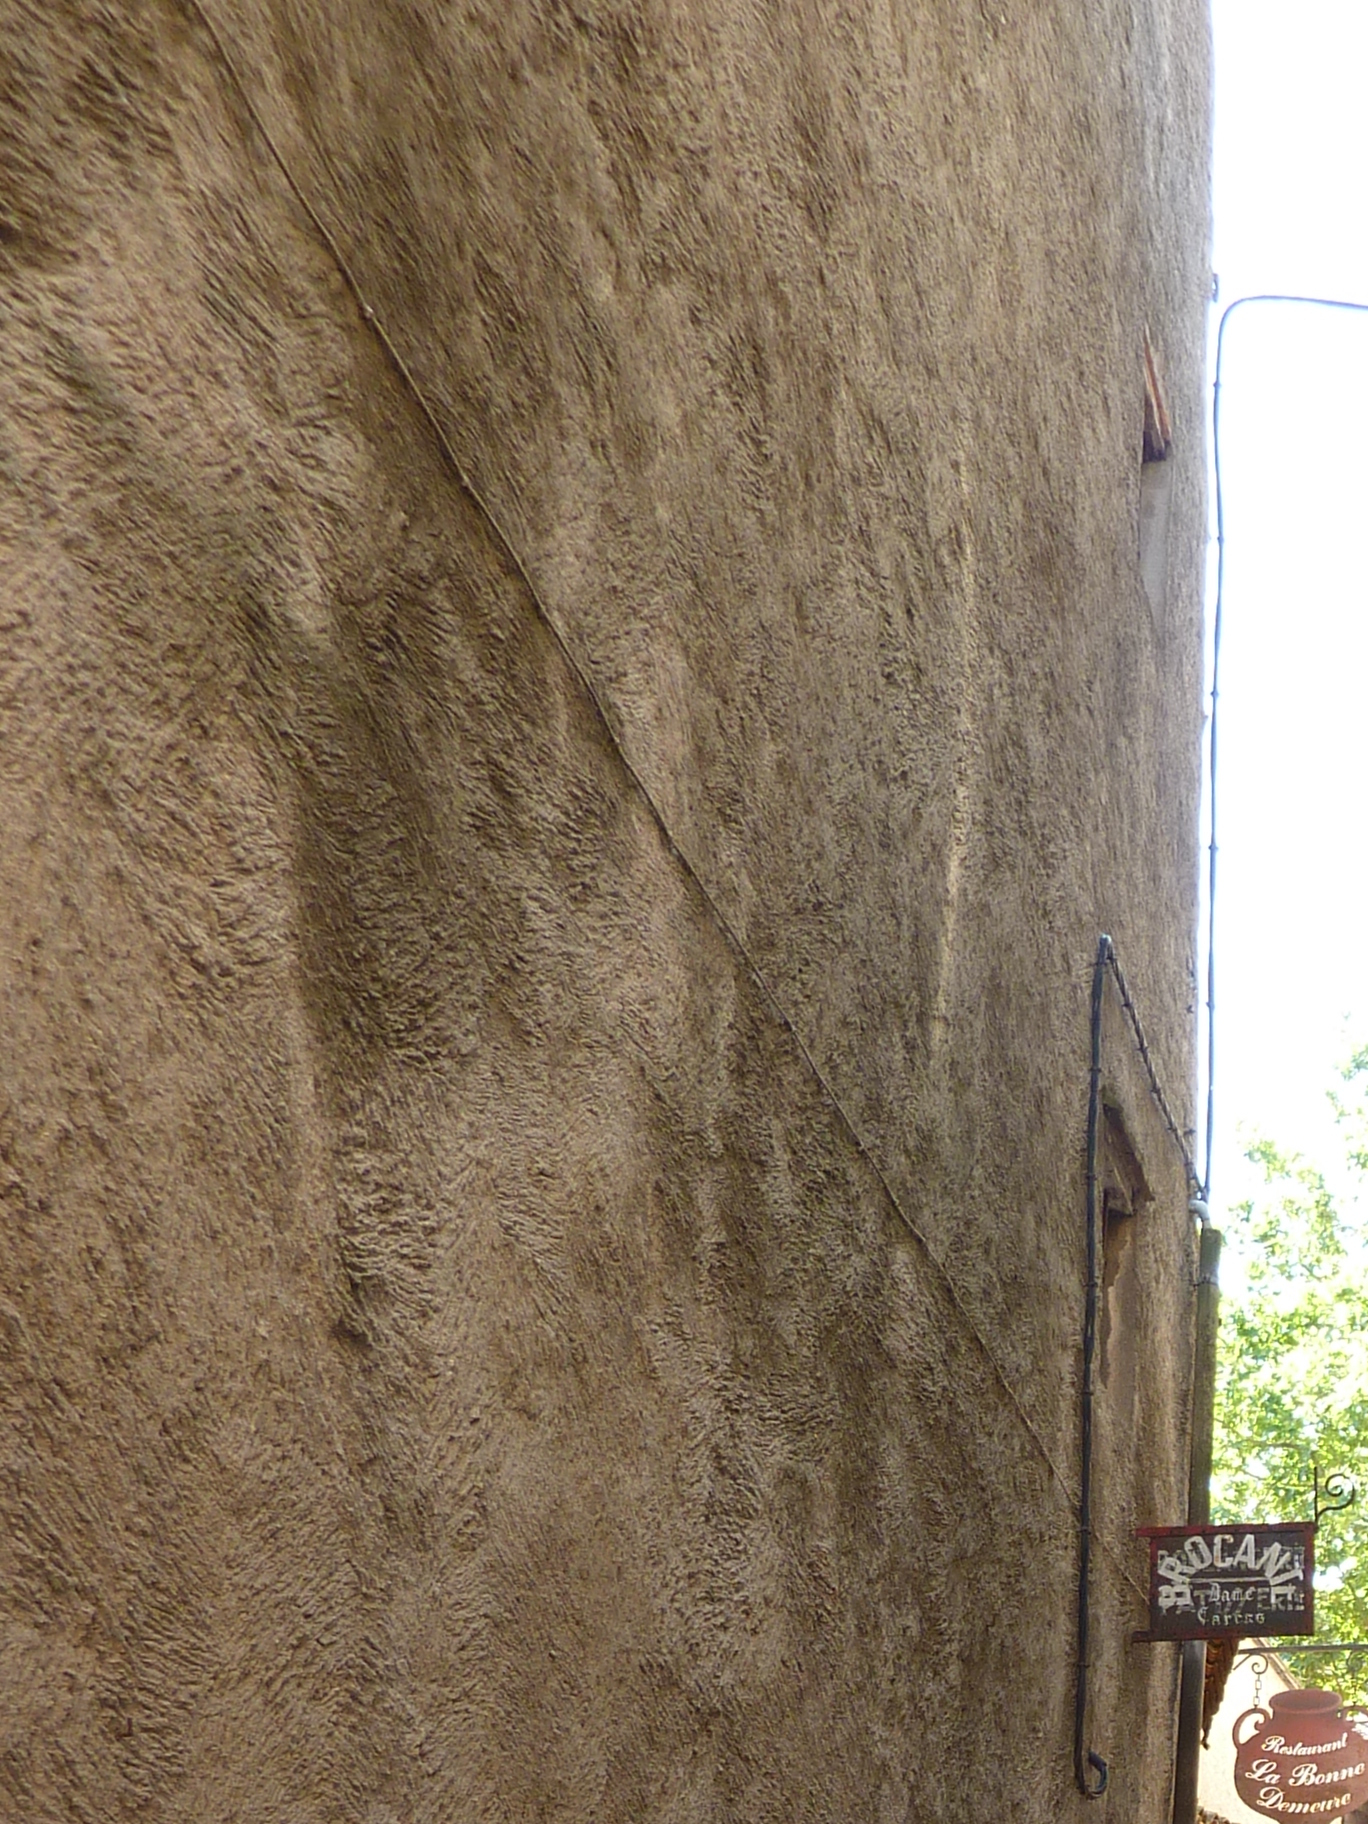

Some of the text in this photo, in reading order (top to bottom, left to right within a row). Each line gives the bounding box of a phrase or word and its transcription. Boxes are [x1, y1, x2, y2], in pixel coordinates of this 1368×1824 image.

[1209, 1582, 1257, 1602] Dame
[1261, 1732, 1348, 1756] Restaurant
[1245, 1758, 1366, 1787] La Bonne
[1256, 1786, 1352, 1814] Demeure
